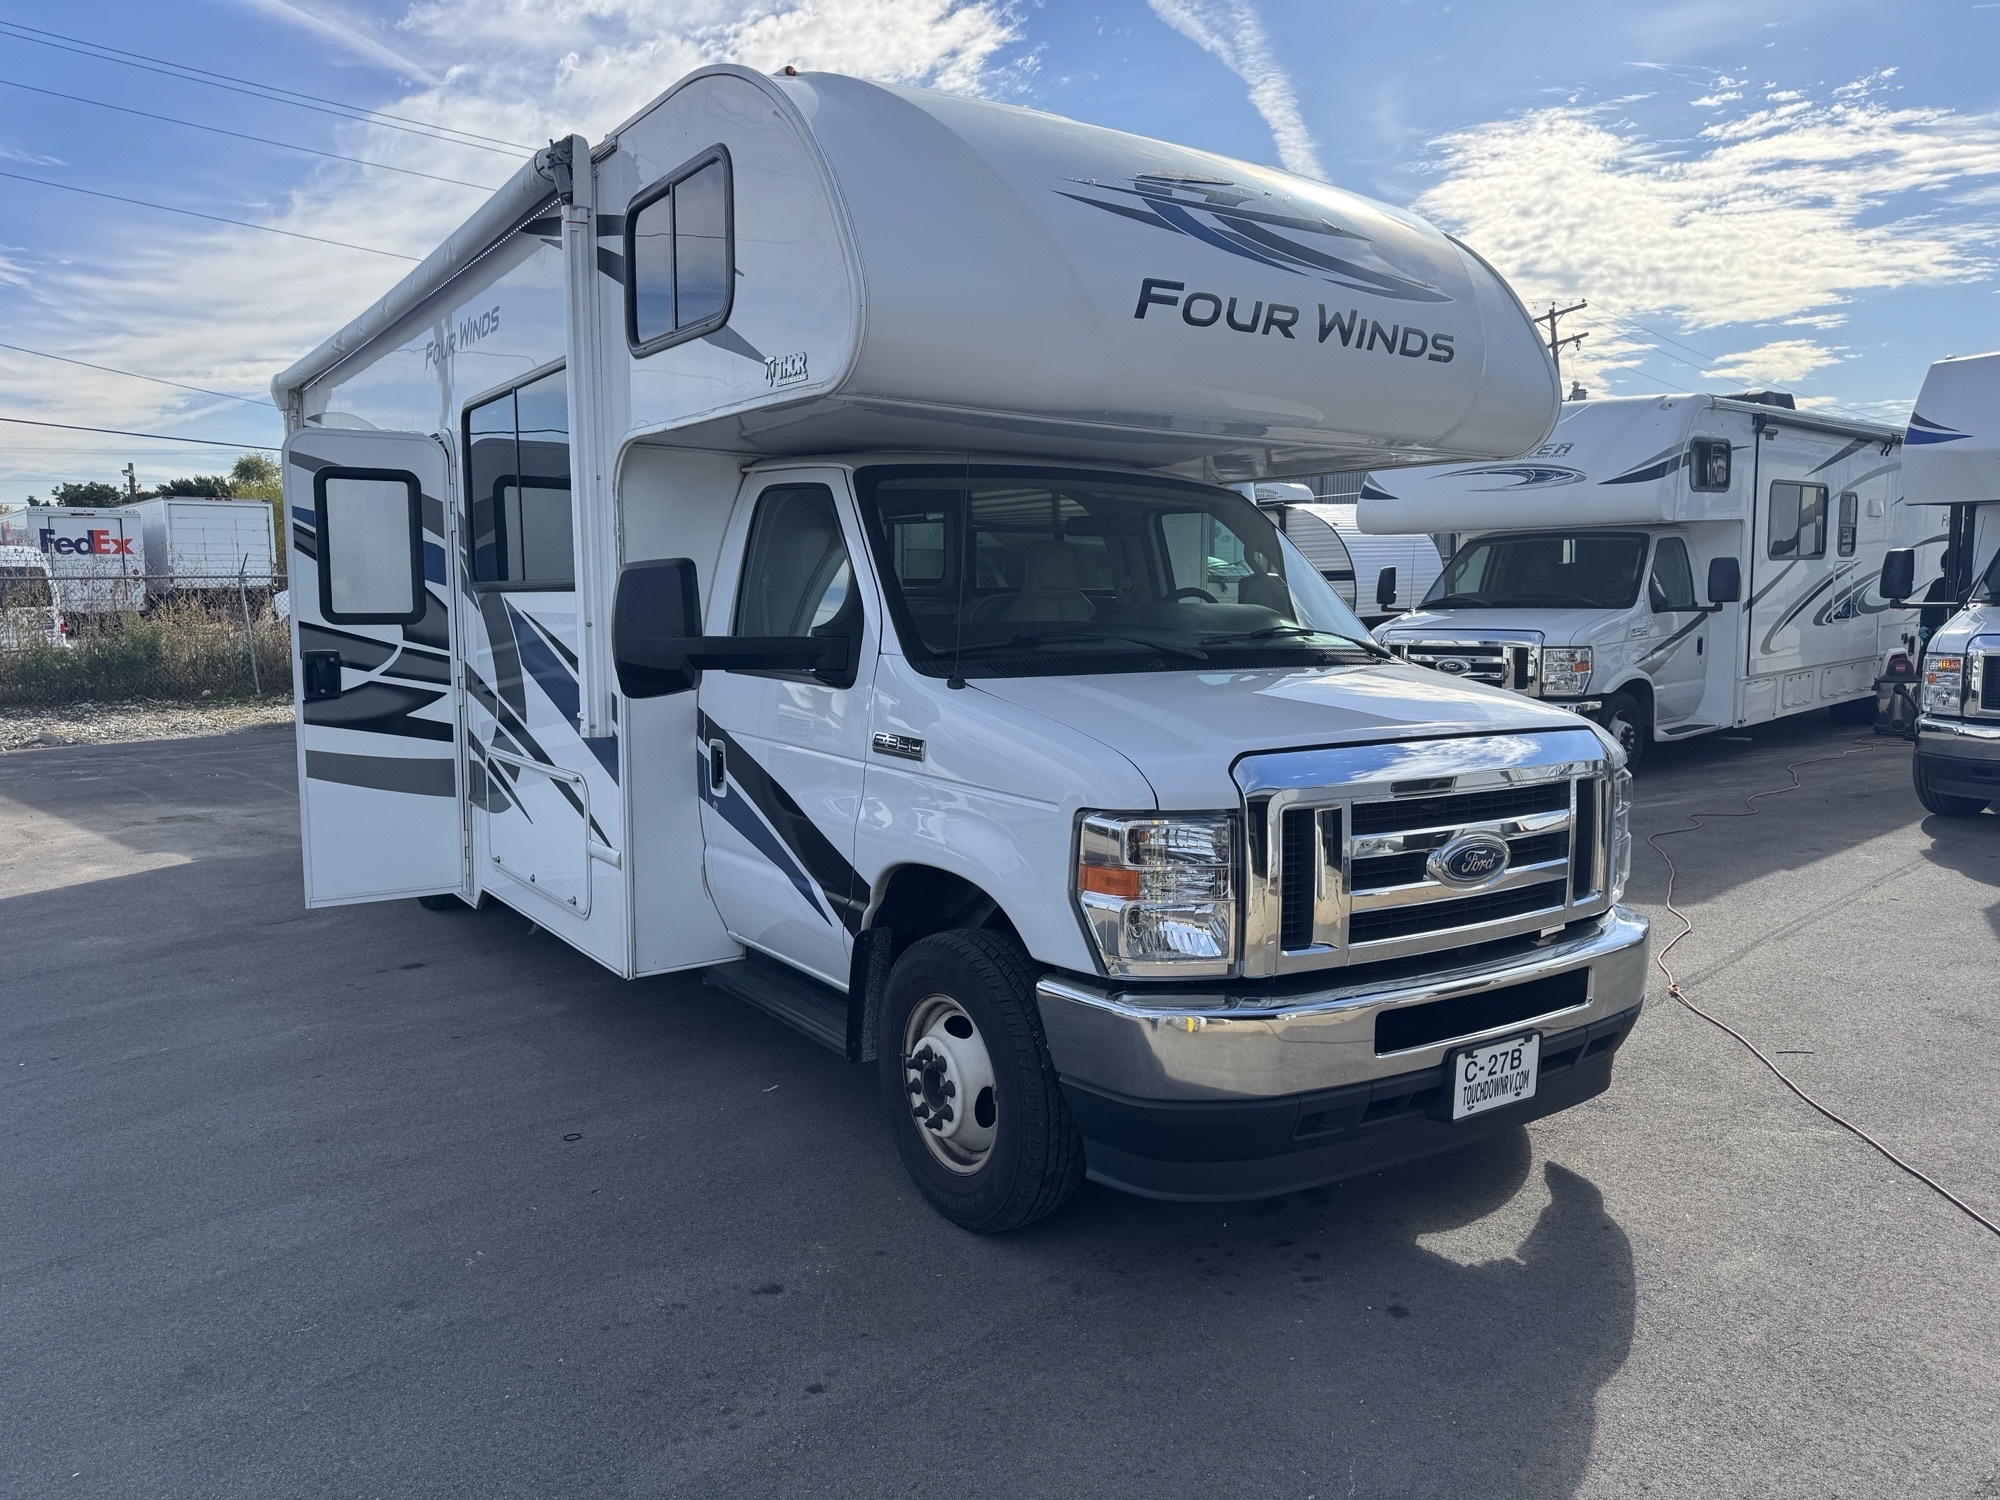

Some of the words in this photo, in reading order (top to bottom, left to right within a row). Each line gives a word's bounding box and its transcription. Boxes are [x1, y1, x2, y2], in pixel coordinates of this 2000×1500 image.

[39, 528, 134, 555] FedEx
[1461, 849, 1496, 873] Ford
[1463, 1069, 1530, 1106] TOUCHDOWNRV.COM
